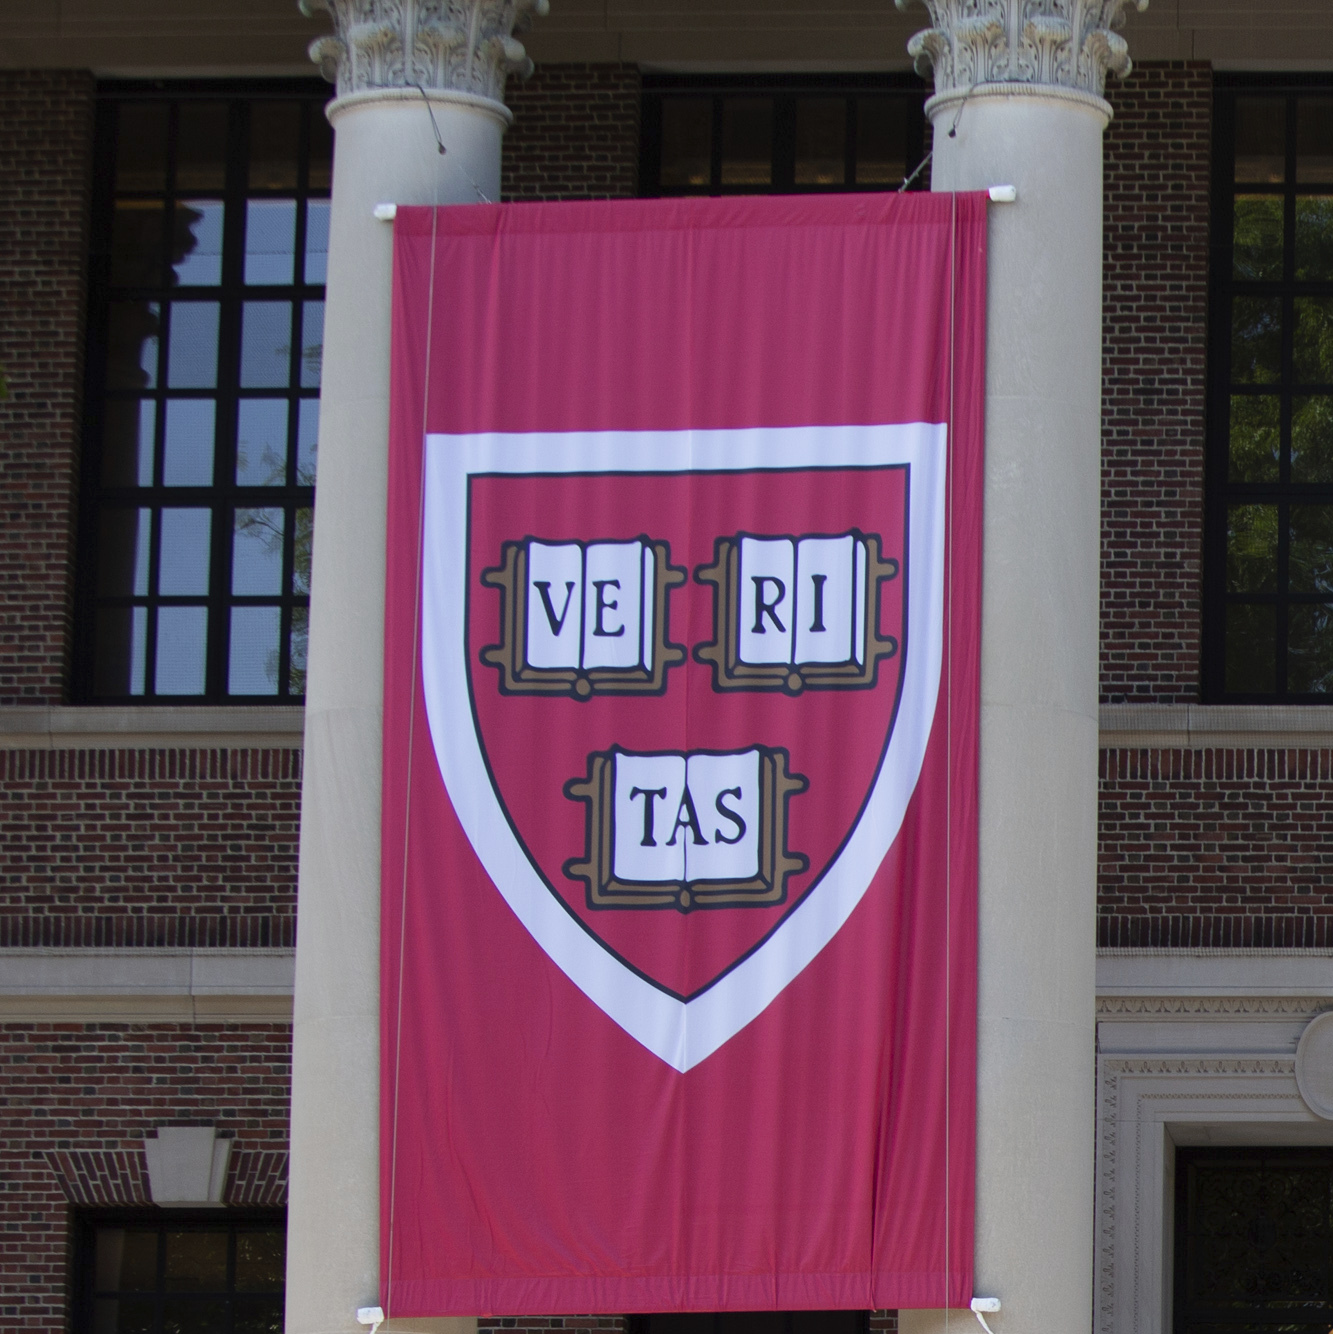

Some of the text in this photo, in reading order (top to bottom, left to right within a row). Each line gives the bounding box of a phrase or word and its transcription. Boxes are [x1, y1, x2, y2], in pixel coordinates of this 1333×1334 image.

[533, 573, 829, 639] VE RI
[629, 786, 748, 847] TAS
